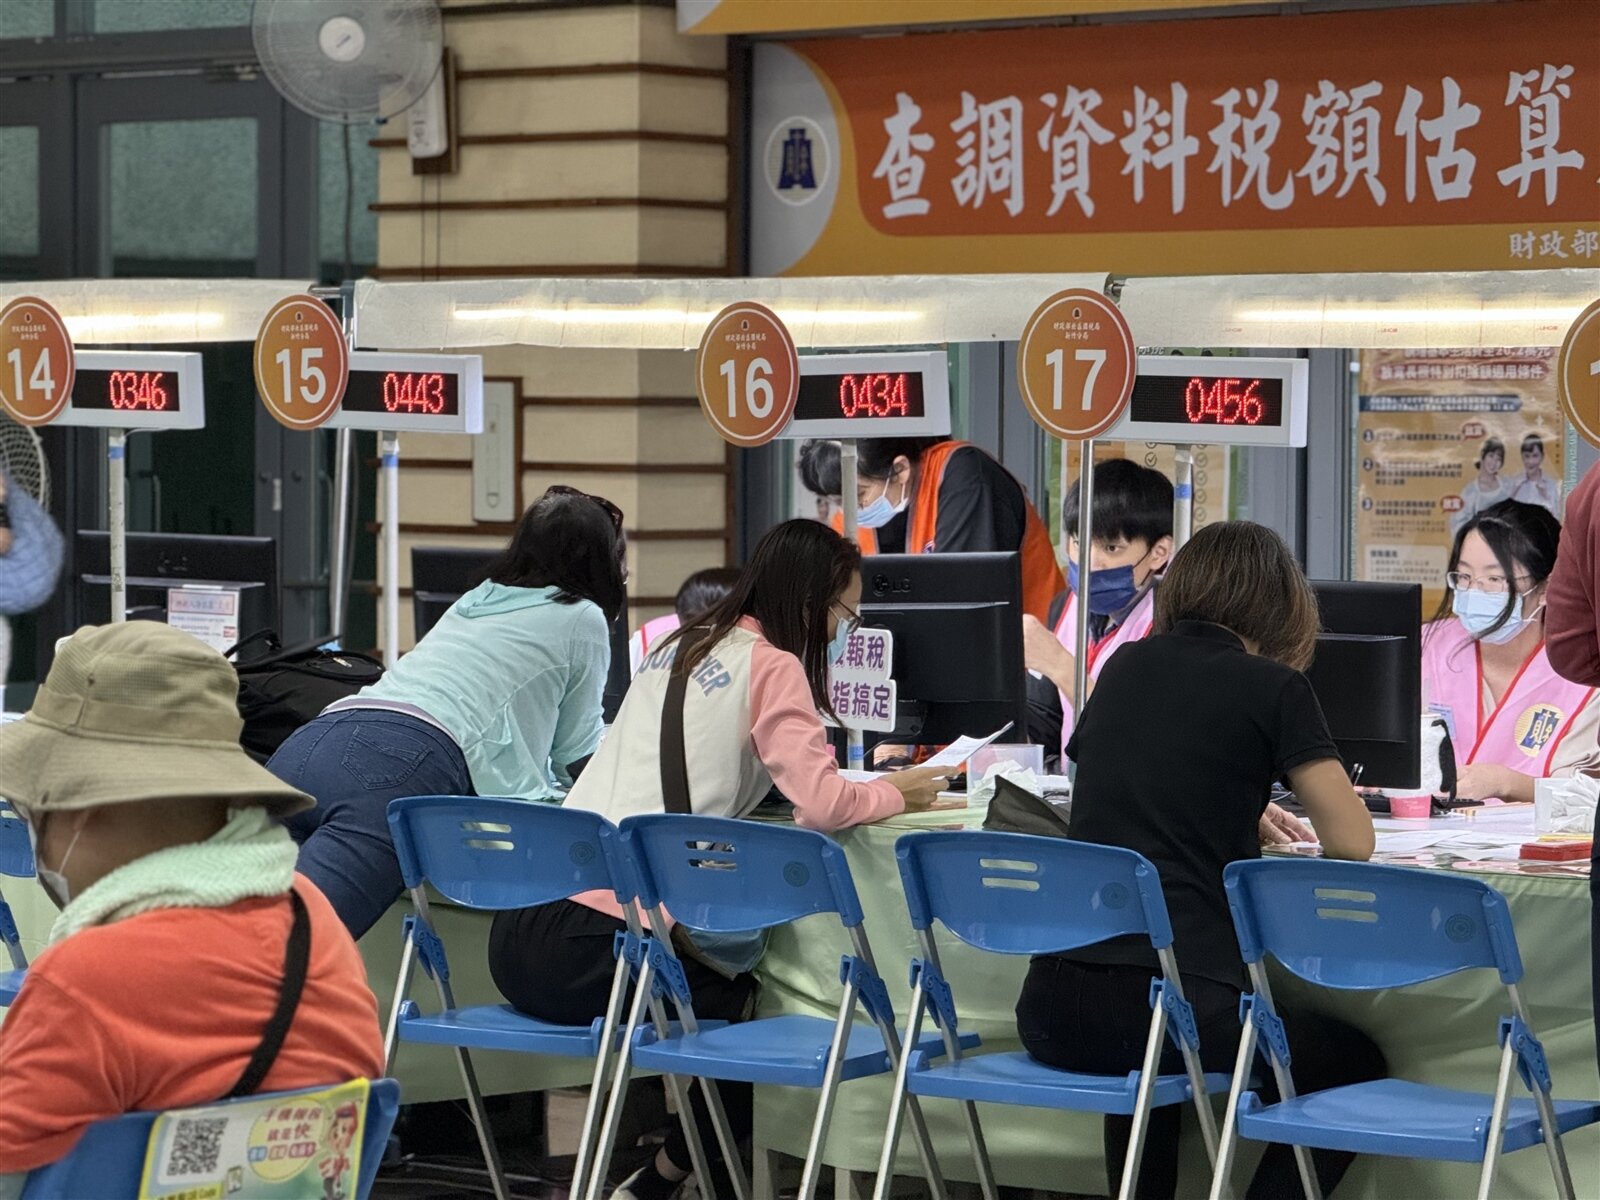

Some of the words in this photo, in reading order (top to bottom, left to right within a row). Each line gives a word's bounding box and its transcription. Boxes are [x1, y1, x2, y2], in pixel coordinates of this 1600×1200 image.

[1509, 228, 1600, 260] 財政部
[7, 347, 55, 401] 14
[109, 372, 166, 410] 0346
[275, 347, 327, 404] 15
[383, 372, 446, 414] 0443
[718, 356, 775, 418] 16
[839, 373, 908, 417] 0434
[1046, 349, 1107, 411] 17
[1185, 378, 1263, 425] 0456
[835, 634, 885, 669] 報稅
[831, 680, 891, 719] 指搞定
